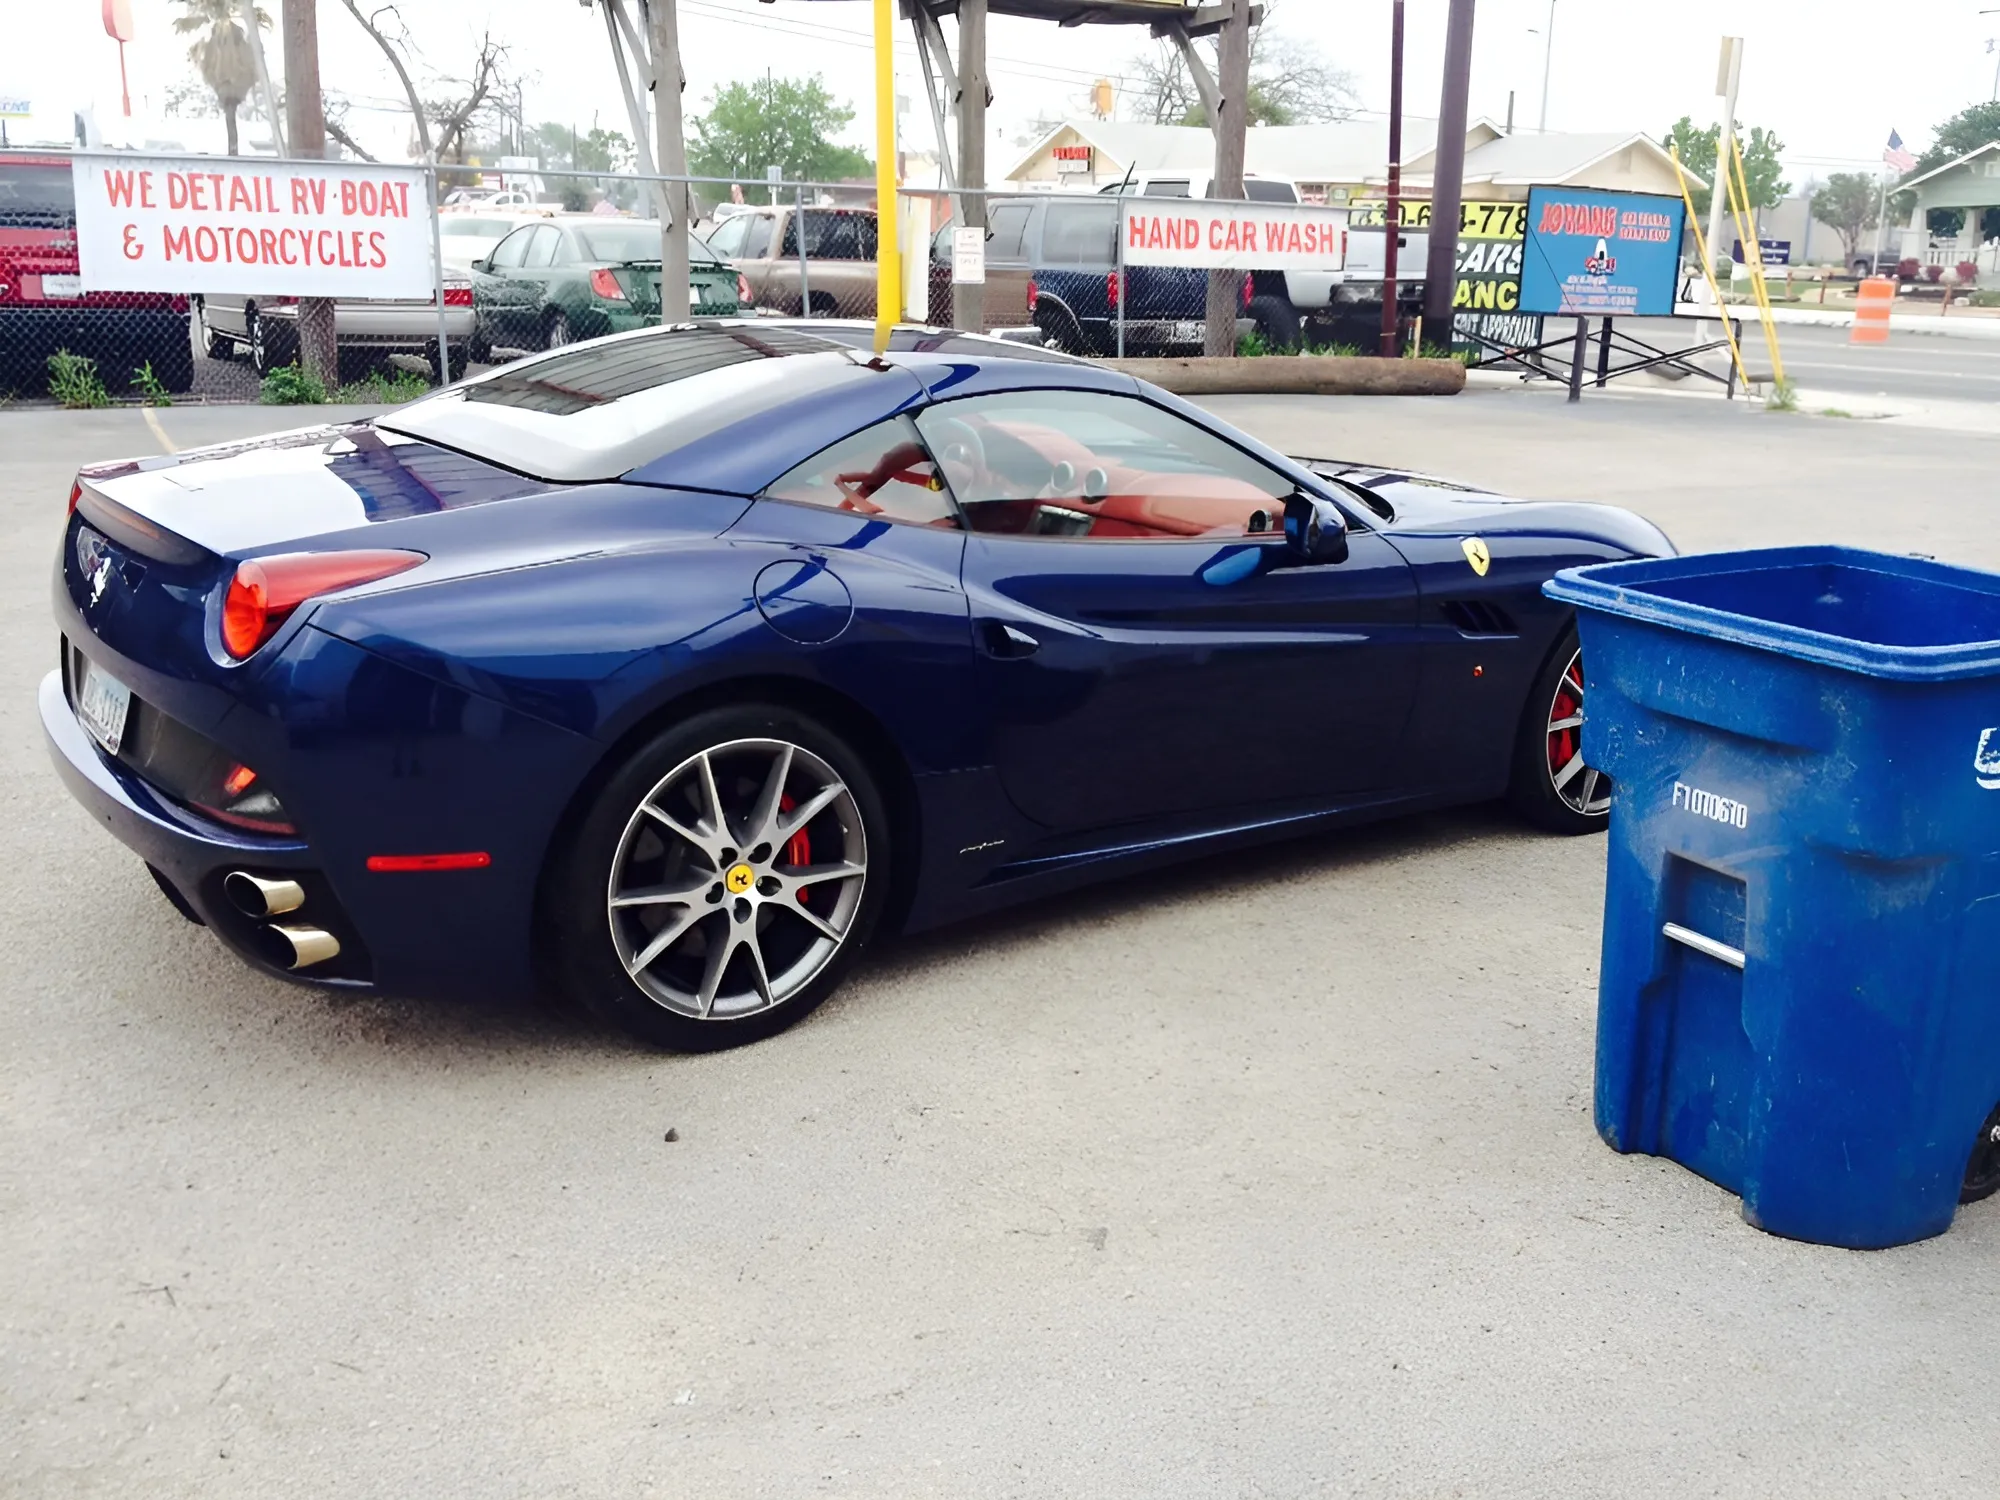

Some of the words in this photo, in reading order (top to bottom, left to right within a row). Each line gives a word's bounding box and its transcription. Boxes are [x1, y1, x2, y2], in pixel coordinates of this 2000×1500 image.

[104, 169, 156, 208] WE
[167, 172, 280, 213] DETAIL
[122, 223, 144, 260] &
[162, 224, 388, 268] MOTORCYCLES
[1129, 215, 1200, 250] HAND
[1208, 219, 1258, 252] CAR
[1265, 221, 1334, 254] WASH
